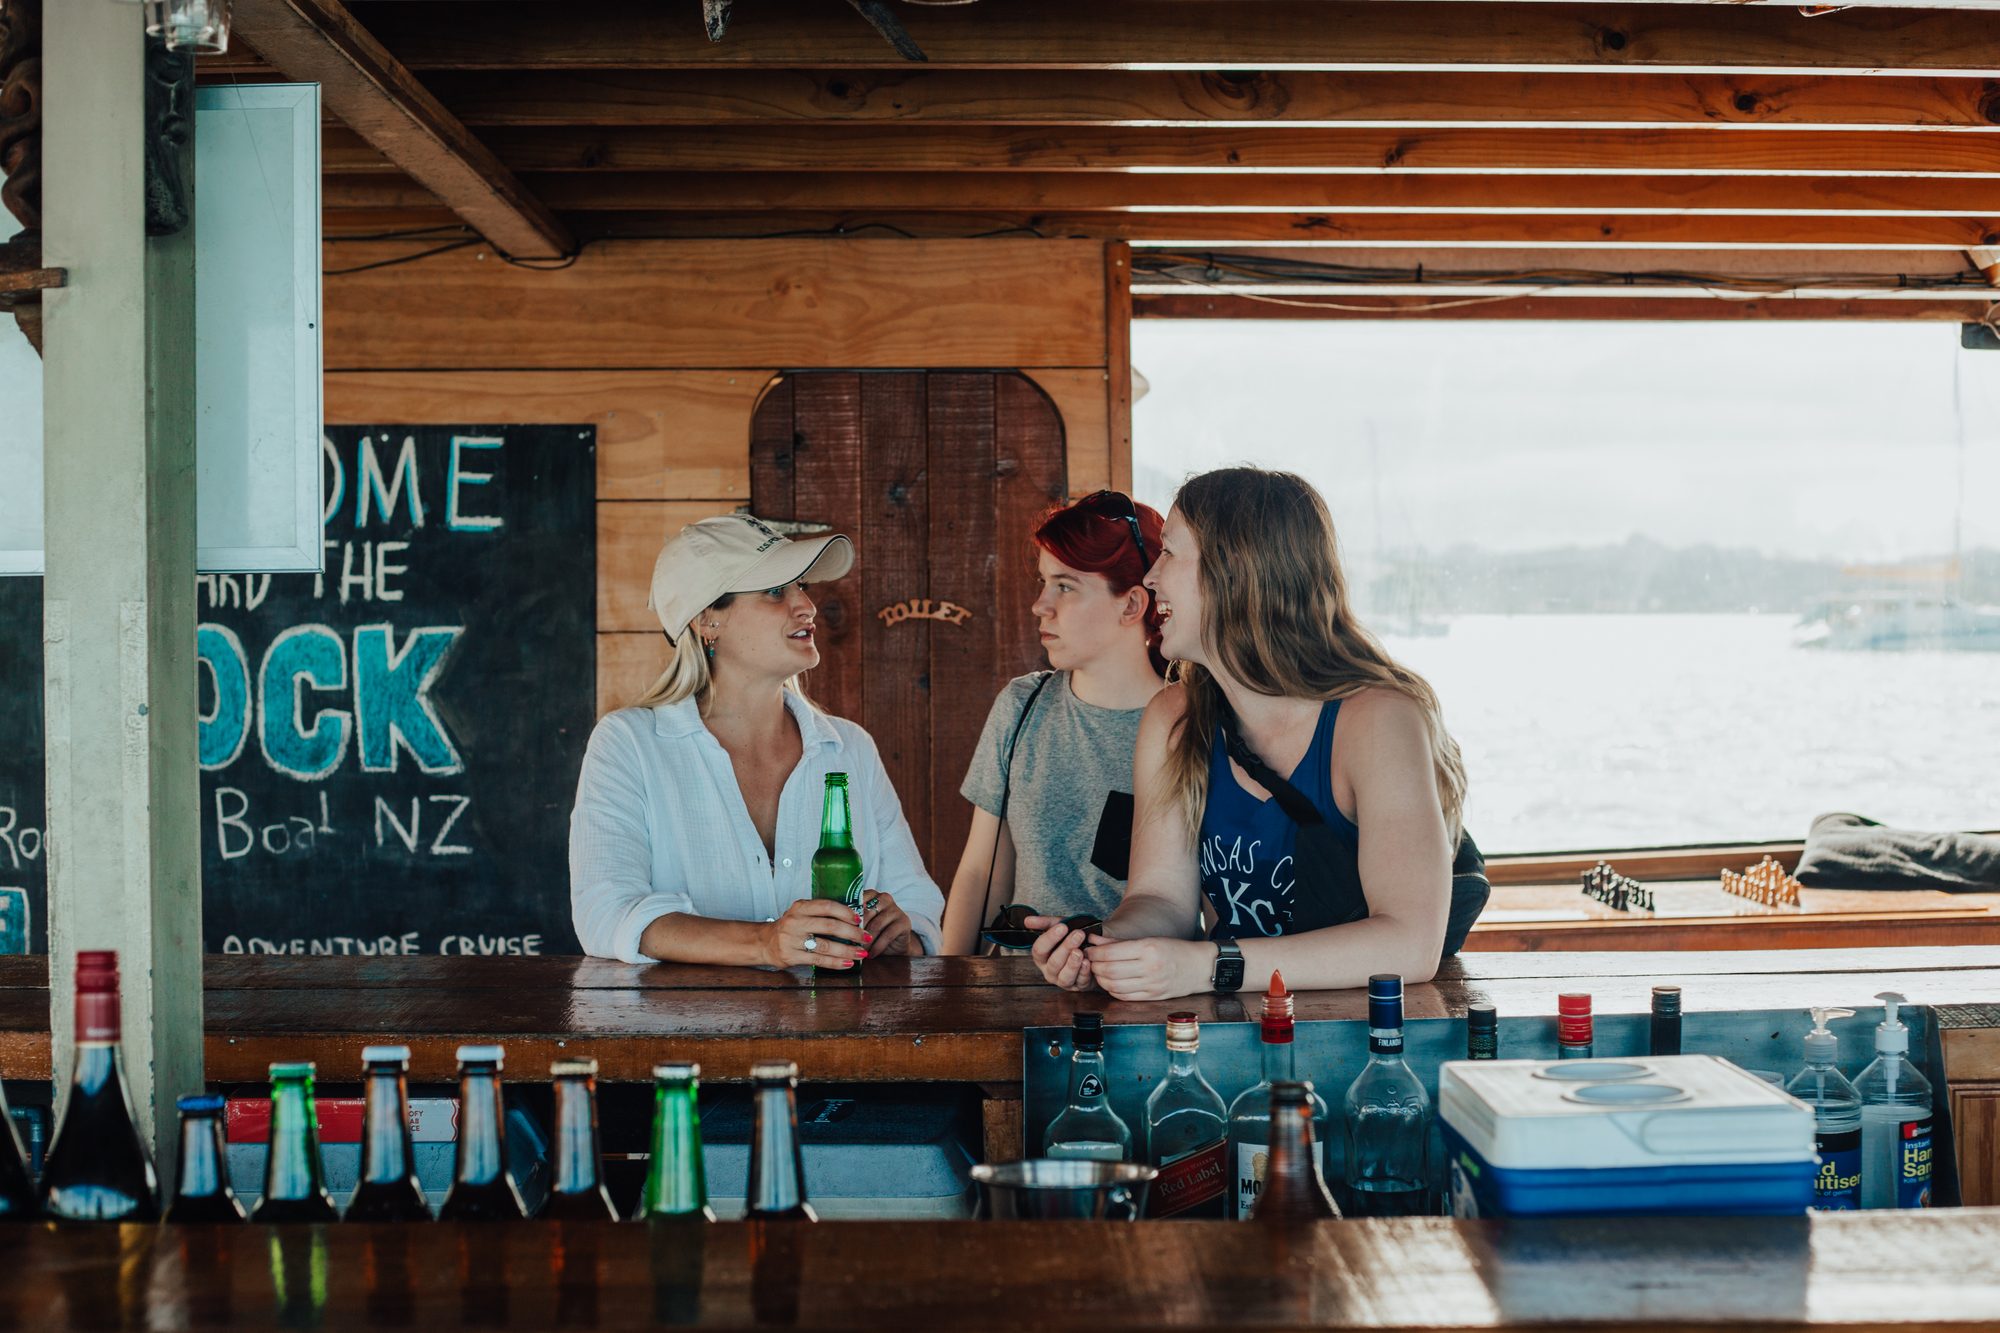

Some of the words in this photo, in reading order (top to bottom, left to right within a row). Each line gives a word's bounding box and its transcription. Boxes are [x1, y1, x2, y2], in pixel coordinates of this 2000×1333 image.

[878, 598, 973, 628] TOILET
[0, 806, 47, 869] Ro
[374, 794, 473, 855] NZ
[222, 932, 420, 956] ADVENTURE
[439, 933, 544, 956] CRUISE
[1159, 1177, 1185, 1198] Red
[1241, 1178, 1264, 1195] MO
